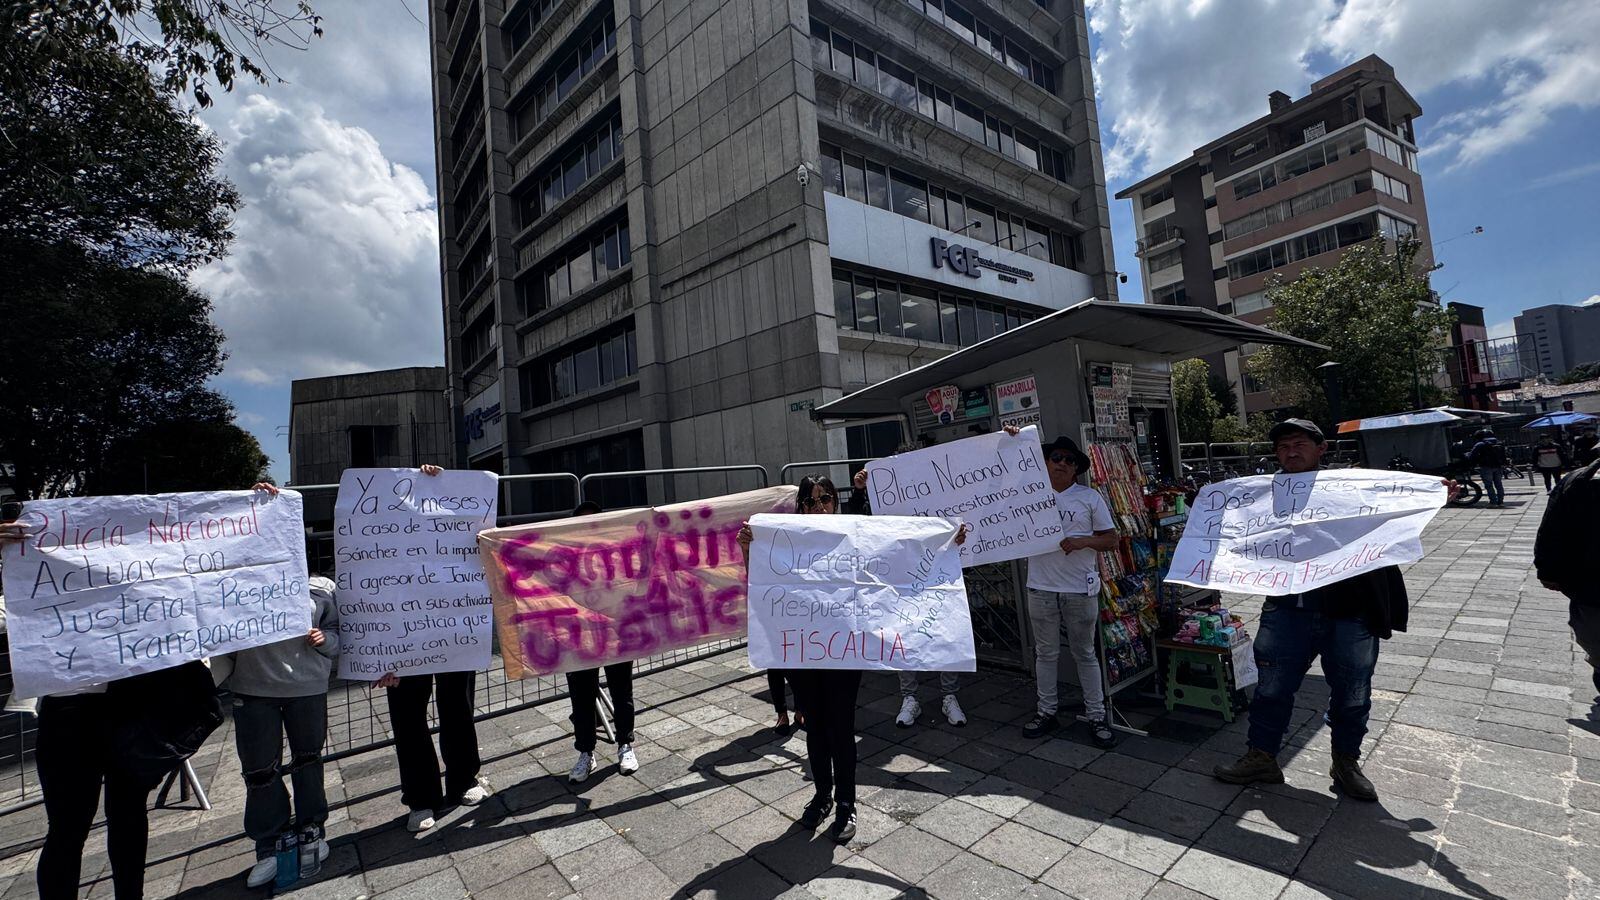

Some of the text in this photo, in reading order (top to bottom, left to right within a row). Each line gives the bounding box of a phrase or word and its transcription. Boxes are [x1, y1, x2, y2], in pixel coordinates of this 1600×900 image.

[930, 236, 981, 279] FGE
[1002, 413, 1040, 427] COPIAS
[931, 451, 1009, 492] Nacional
[1018, 446, 1041, 472] del
[352, 475, 379, 515] Ya
[388, 478, 413, 511] 2
[421, 495, 480, 513] meses
[935, 486, 1019, 518] necesitamos
[1204, 490, 1256, 513] Dos
[1373, 481, 1415, 497] sin
[148, 502, 262, 545] Nacional
[338, 517, 475, 537] el caso de Javier
[1017, 524, 1030, 542] el
[1033, 525, 1062, 538] caso
[1204, 498, 1329, 538] Respuestas
[337, 539, 480, 563] Sánchez en la impun
[769, 527, 892, 577] Queremos
[1198, 539, 1295, 561] Justicia
[31, 550, 225, 599] Actuar con
[337, 564, 486, 596] El agresor de Javier
[1185, 559, 1288, 588] Atención
[33, 593, 185, 639] Justicia
[218, 570, 302, 609] Respeto
[401, 599, 421, 611] en
[426, 598, 450, 611] sus
[762, 585, 884, 622] Respuestas
[101, 609, 288, 665] Transparencia
[340, 614, 490, 640] exigimos justicia que
[358, 641, 415, 656] continue
[421, 638, 449, 651] con
[455, 632, 479, 645] las
